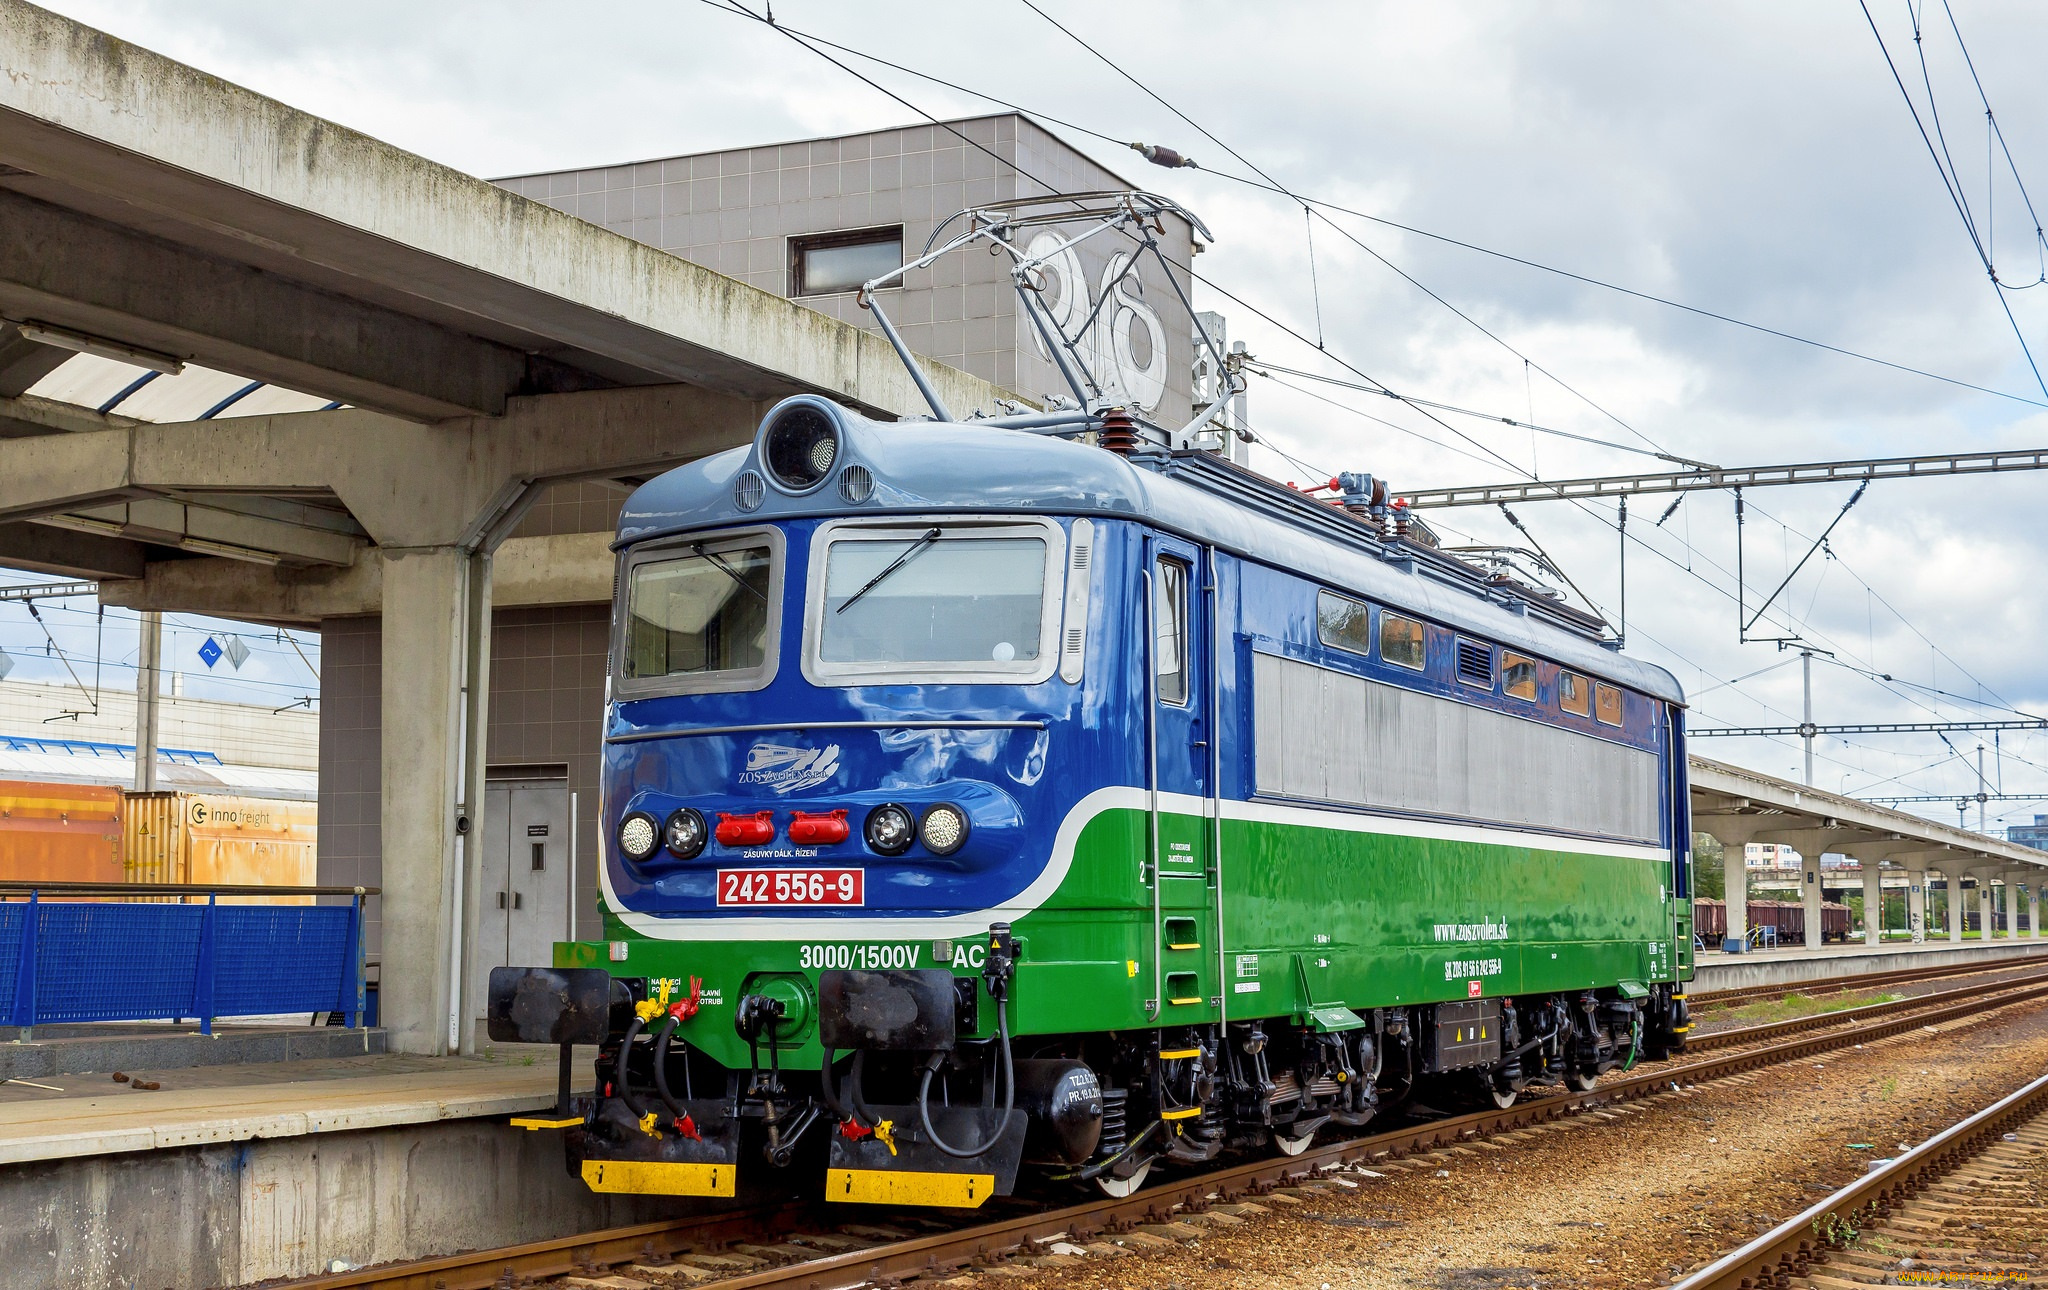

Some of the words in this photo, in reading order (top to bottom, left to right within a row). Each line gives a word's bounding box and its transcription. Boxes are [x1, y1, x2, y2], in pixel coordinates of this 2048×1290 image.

[738, 771, 761, 784] ZOS
[211, 808, 237, 822] inno
[239, 809, 270, 828] freight
[743, 849, 773, 859] ZÁSUVKY
[774, 848, 794, 858] DÁLK.
[1139, 860, 1145, 883] 2
[725, 873, 769, 902] 242
[775, 873, 854, 902] 556-9
[1434, 916, 1508, 941] www.zoszvolen.sk
[800, 945, 919, 970] 3000/1500V
[952, 945, 985, 969] AC
[1445, 961, 1452, 980] SK
[1476, 960, 1480, 976] 6
